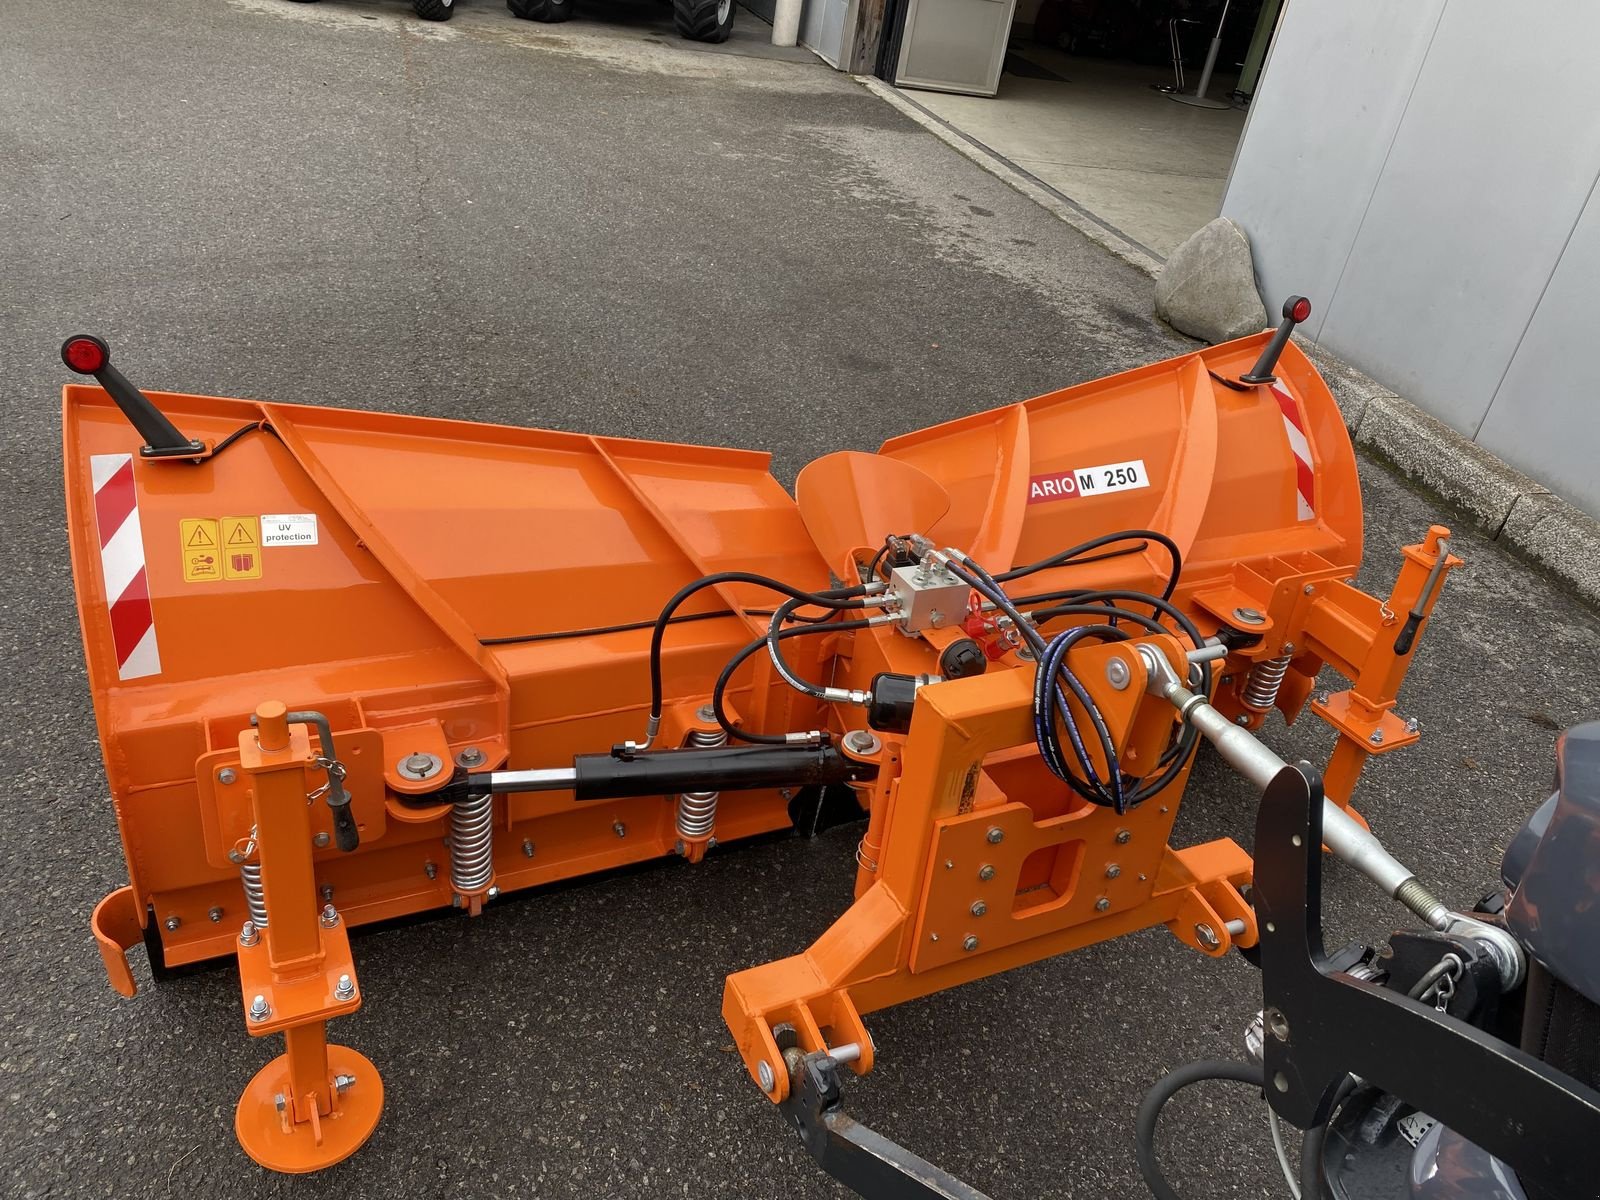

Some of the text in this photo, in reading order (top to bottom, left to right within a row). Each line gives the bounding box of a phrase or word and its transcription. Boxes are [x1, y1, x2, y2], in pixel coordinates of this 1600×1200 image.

[1079, 474, 1095, 490] M
[1103, 467, 1138, 487] 250
[278, 523, 292, 532] UV
[266, 532, 312, 543] protection
